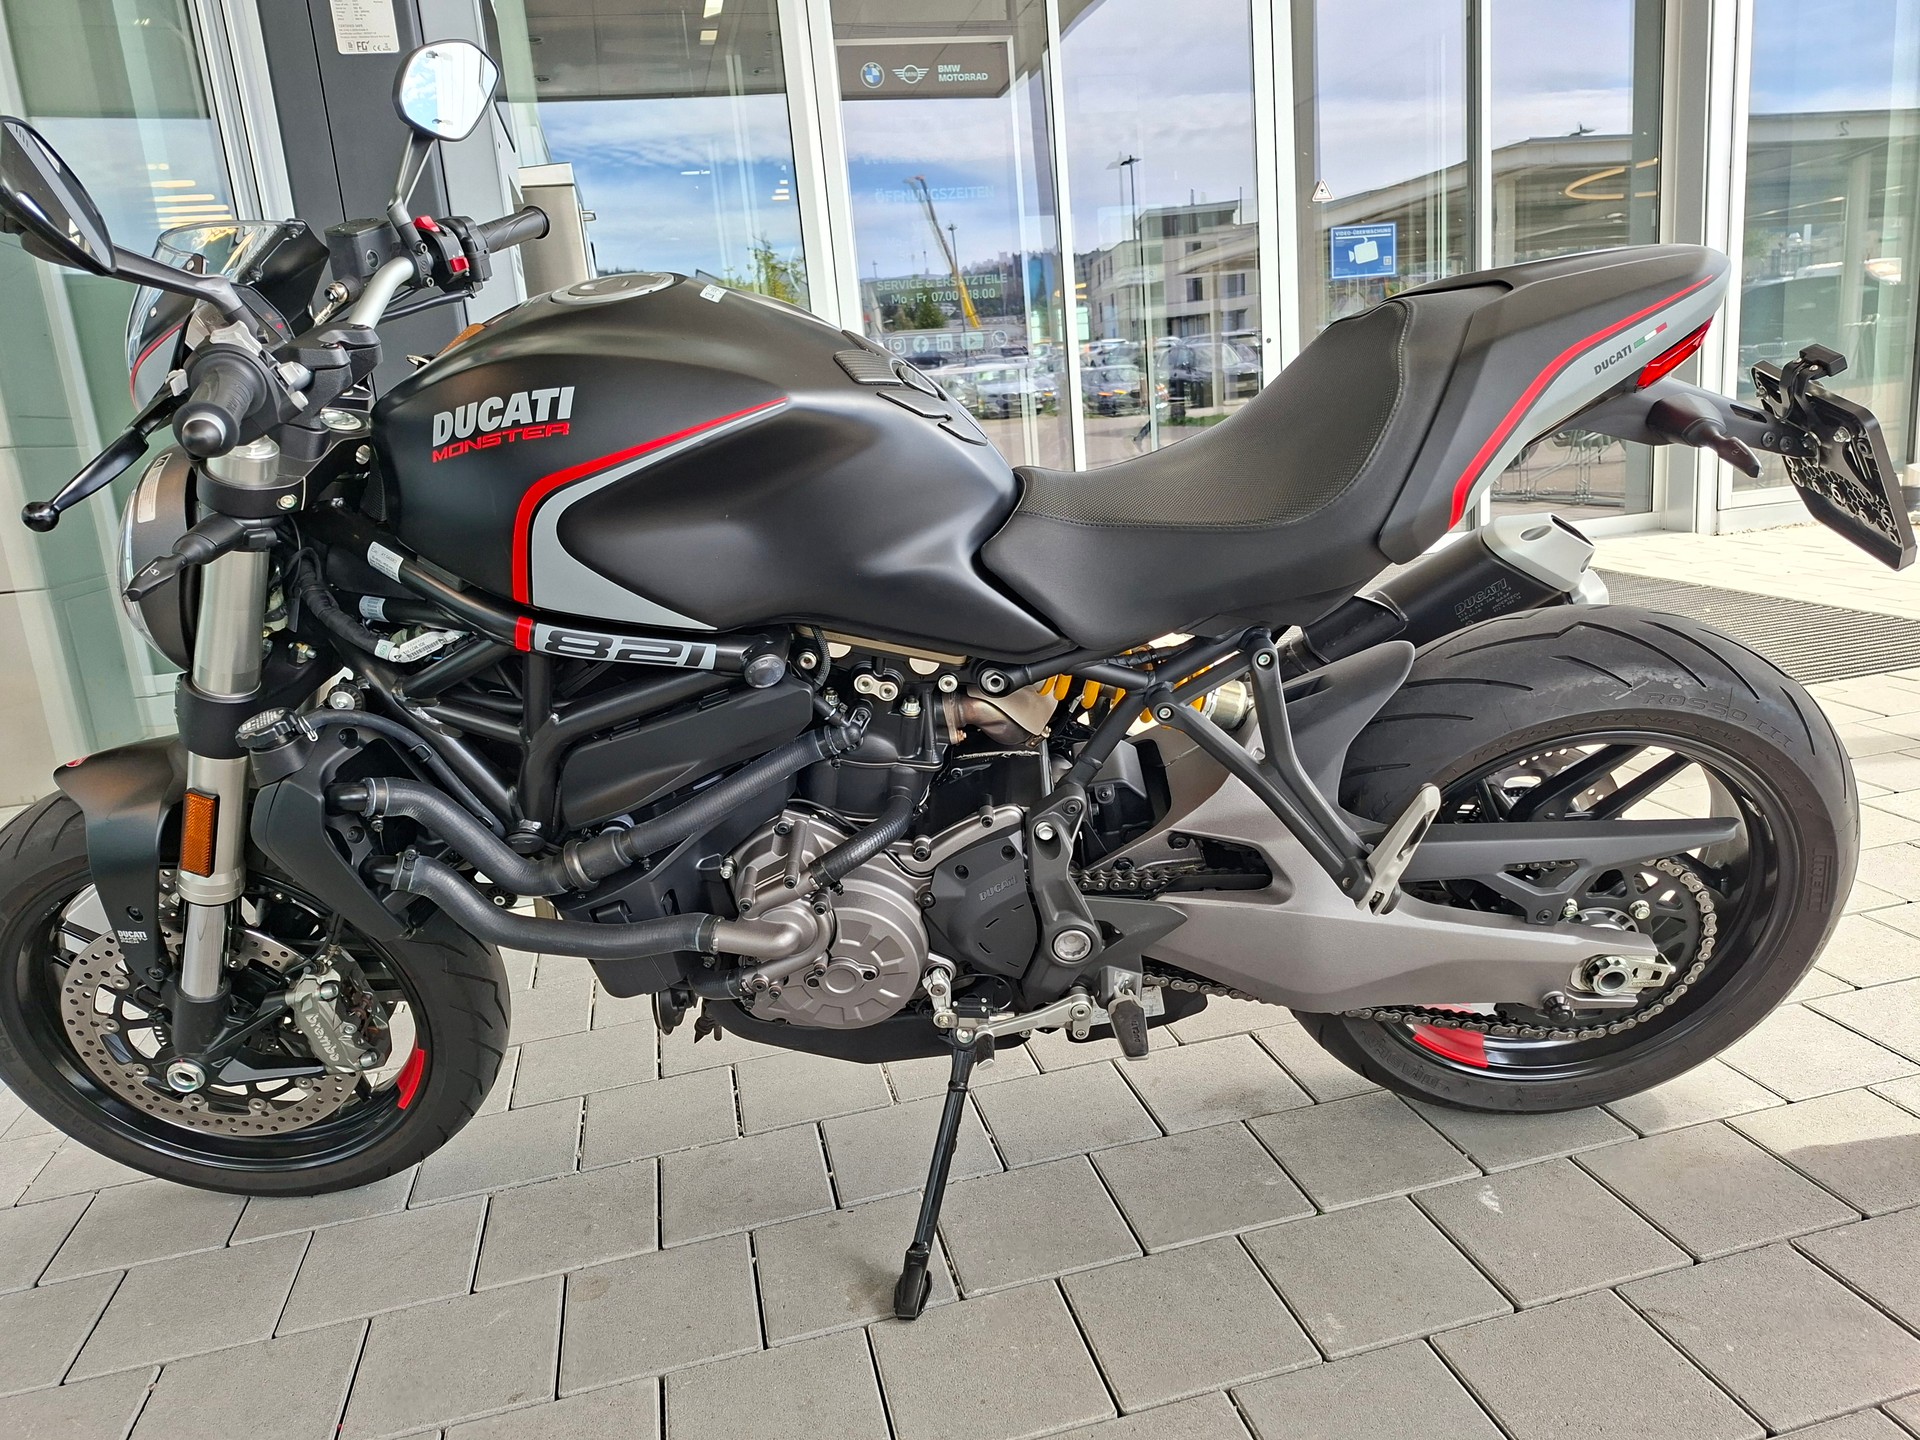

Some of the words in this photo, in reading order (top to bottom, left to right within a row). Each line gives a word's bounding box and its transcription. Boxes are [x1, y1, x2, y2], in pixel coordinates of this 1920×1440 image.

[937, 64, 961, 73] BMW
[938, 72, 989, 82] MOTORRAD
[874, 185, 995, 203] ÖFFNUNGSZEITEN
[1335, 227, 1392, 237] VIDEO-ÜBERWACHUNG
[877, 278, 923, 291] SERVICE
[937, 273, 1008, 287] ERSATZTEILE
[891, 294, 907, 305] Mo
[916, 292, 927, 303] Fr
[931, 291, 959, 302] 07.00
[969, 288, 996, 300] 18.00
[1593, 344, 1632, 376] DUCATI
[433, 386, 575, 447] DUCATI
[432, 422, 570, 463] MONSTER
[1454, 577, 1507, 616] DUCATI
[544, 629, 707, 667] 821
[1645, 691, 1748, 723] ROSSO
[979, 875, 1017, 901] DUCATI
[117, 930, 148, 939] DUCATI
[305, 1012, 340, 1062] brembo
